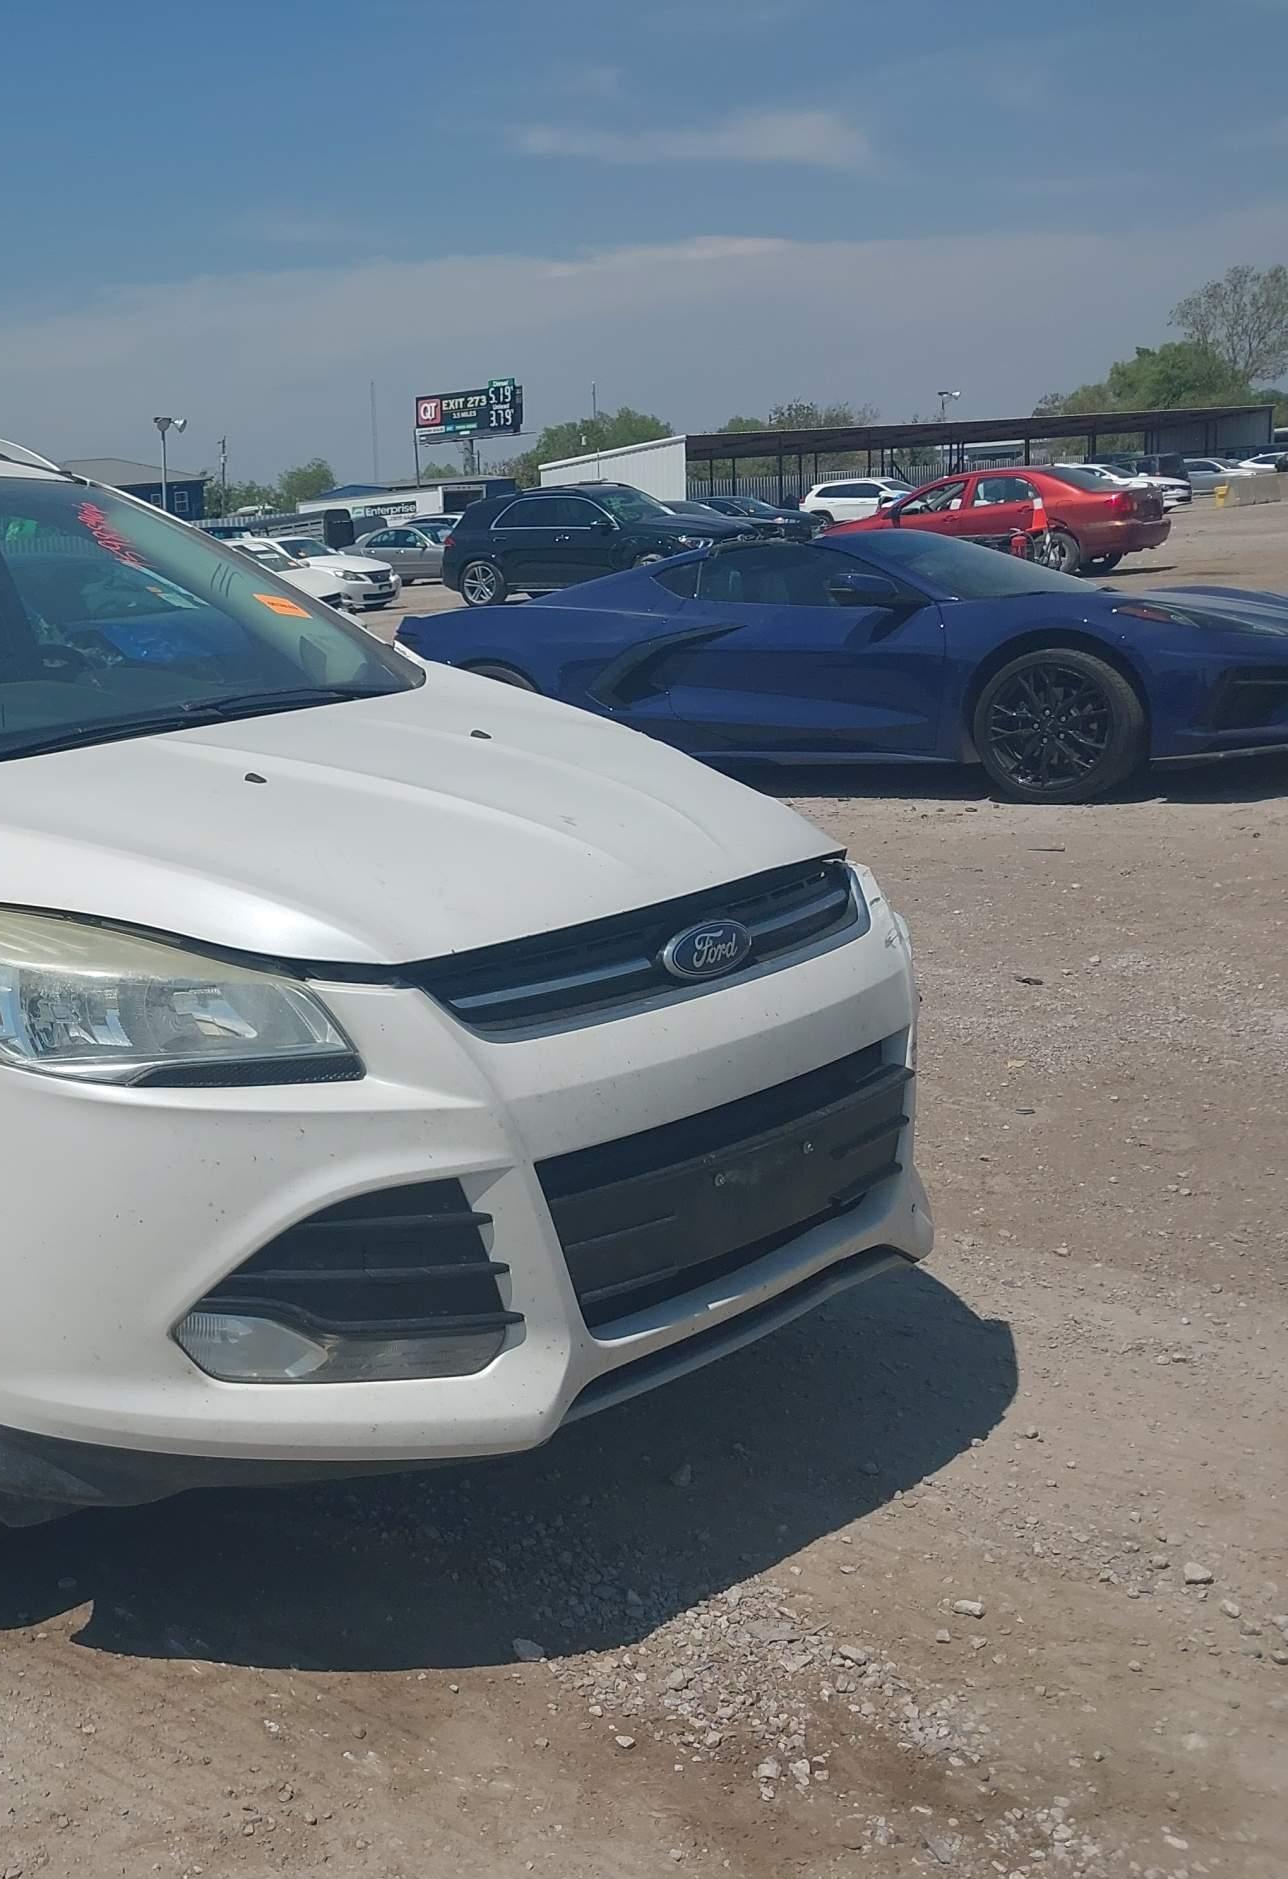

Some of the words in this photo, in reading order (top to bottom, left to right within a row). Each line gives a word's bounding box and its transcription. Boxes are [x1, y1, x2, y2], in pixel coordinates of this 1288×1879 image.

[420, 402, 437, 420] QT
[442, 398, 465, 411] EXIT
[467, 396, 487, 408] 273
[365, 503, 416, 517] Enterprise
[692, 929, 739, 968] Ford
